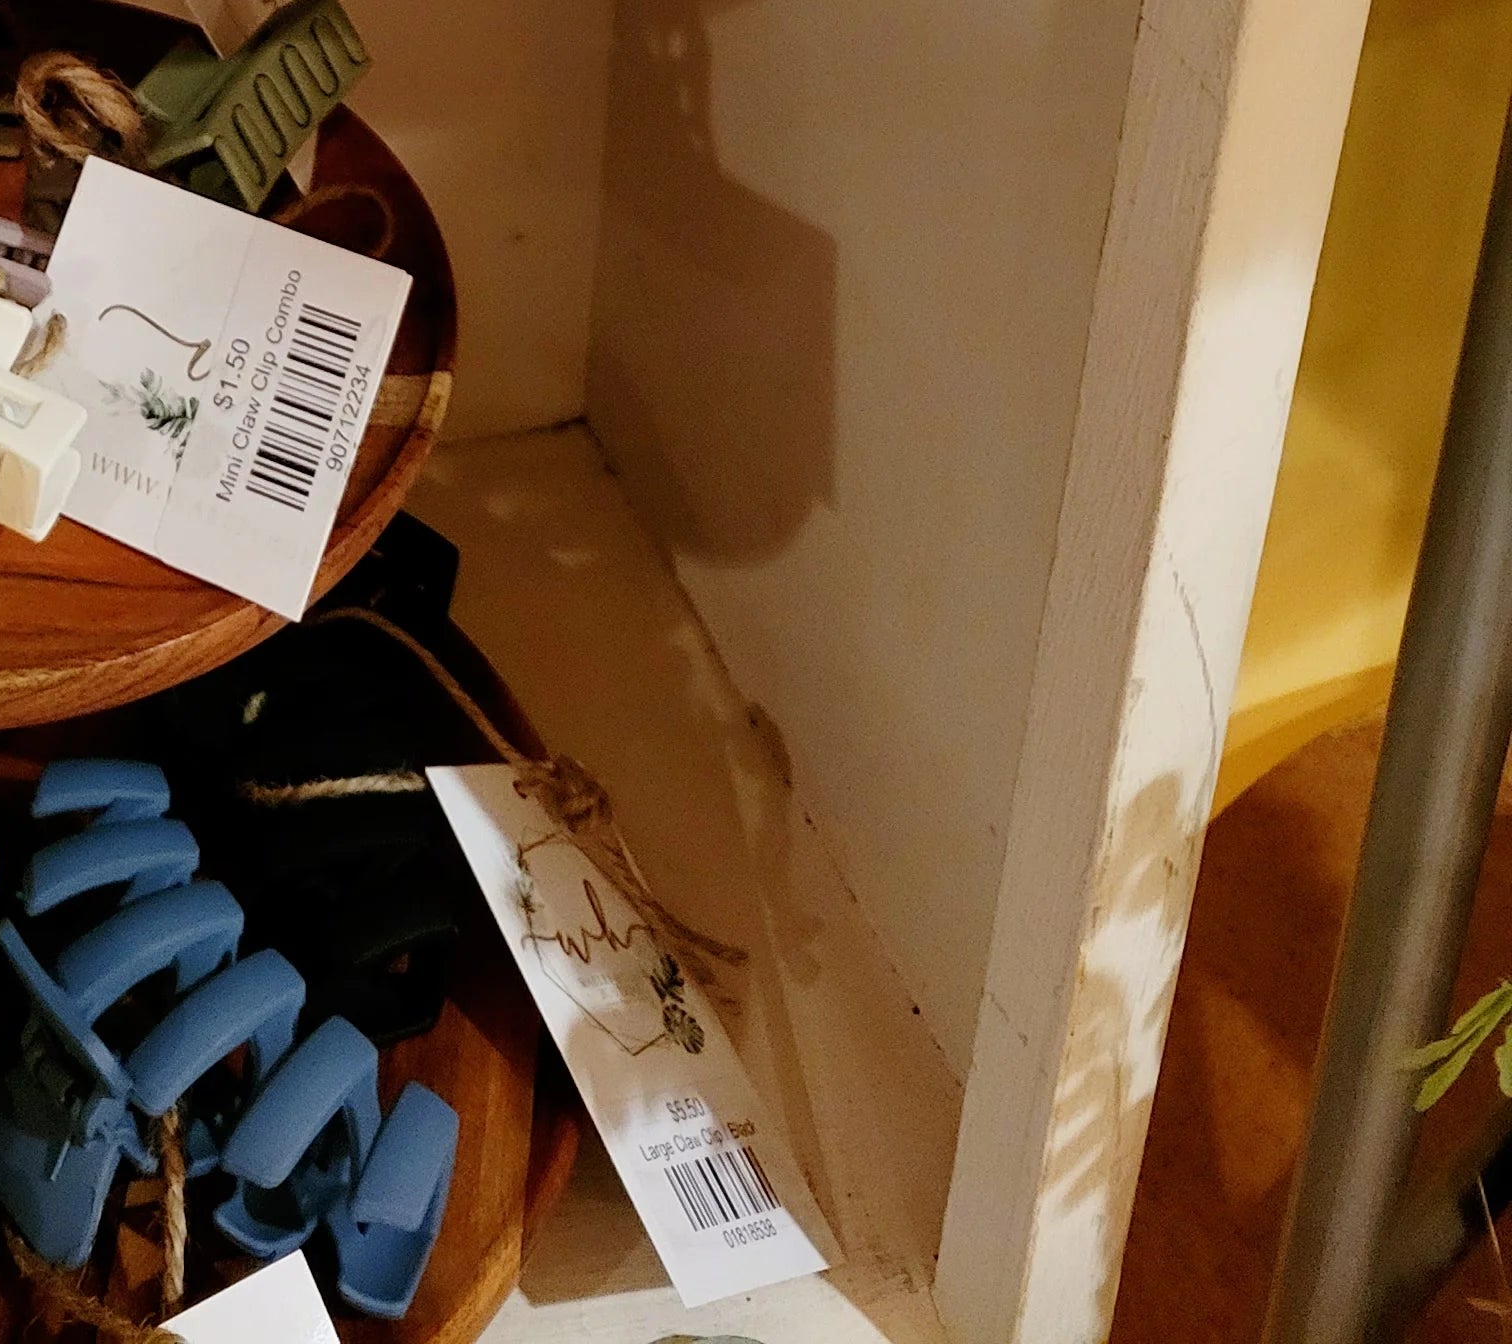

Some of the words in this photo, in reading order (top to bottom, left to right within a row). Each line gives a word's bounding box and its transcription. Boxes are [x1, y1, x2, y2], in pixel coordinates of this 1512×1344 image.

[213, 338, 251, 411] $1.50
[215, 454, 244, 502] Mini
[232, 395, 263, 450] Claw
[251, 351, 278, 391] Clip
[265, 269, 302, 345] Combo
[325, 364, 371, 473] 90712234
[639, 1142, 676, 1163] Large
[673, 1134, 702, 1153] Claw
[700, 1127, 724, 1149] Clip
[666, 1097, 705, 1123] $5.50
